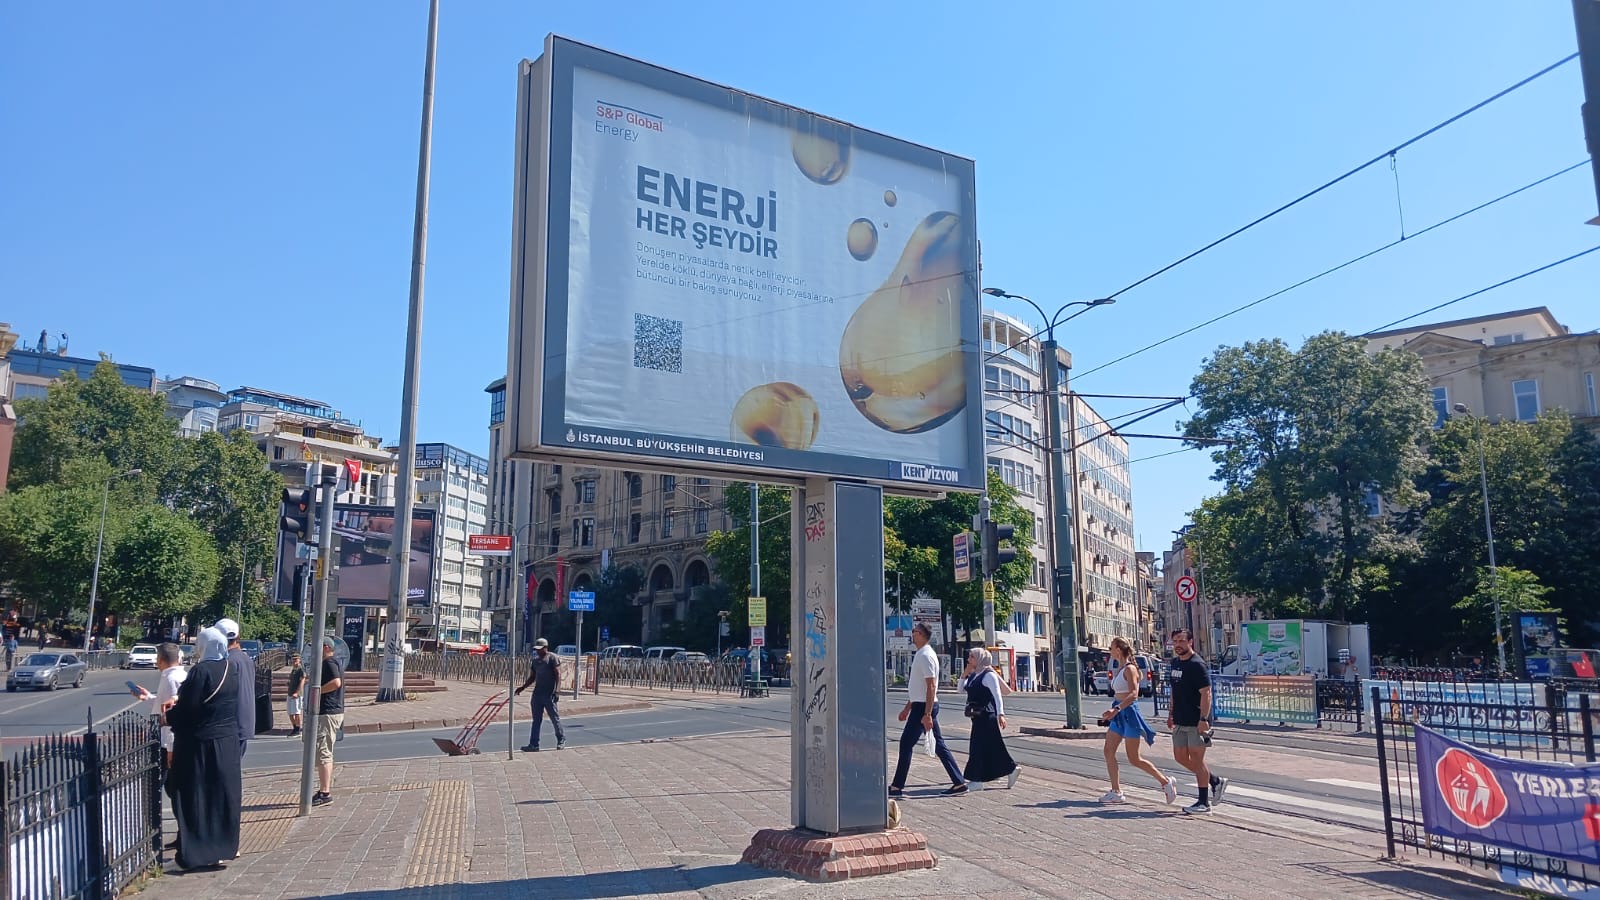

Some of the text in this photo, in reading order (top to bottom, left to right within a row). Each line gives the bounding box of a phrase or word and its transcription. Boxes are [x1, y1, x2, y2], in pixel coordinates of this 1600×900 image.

[595, 120, 639, 142] Energy
[596, 105, 664, 132] S&P Global
[636, 164, 778, 233] ENERJİ
[636, 207, 779, 260] HER ŞEYDİR
[636, 241, 677, 260] Dönüşen
[678, 253, 730, 272] piyasalarda
[731, 263, 755, 277] netlik
[636, 255, 670, 271] Yerelde
[699, 269, 736, 287] dünyaya
[761, 282, 785, 296] enerji
[786, 287, 835, 305] piyasalarına
[678, 276, 691, 289] bir
[692, 278, 716, 295] bakış
[578, 431, 765, 461] İSTANBUL BÜYÜKŞEHİR BELEDİYESİ
[471, 537, 500, 545] TERSANE
